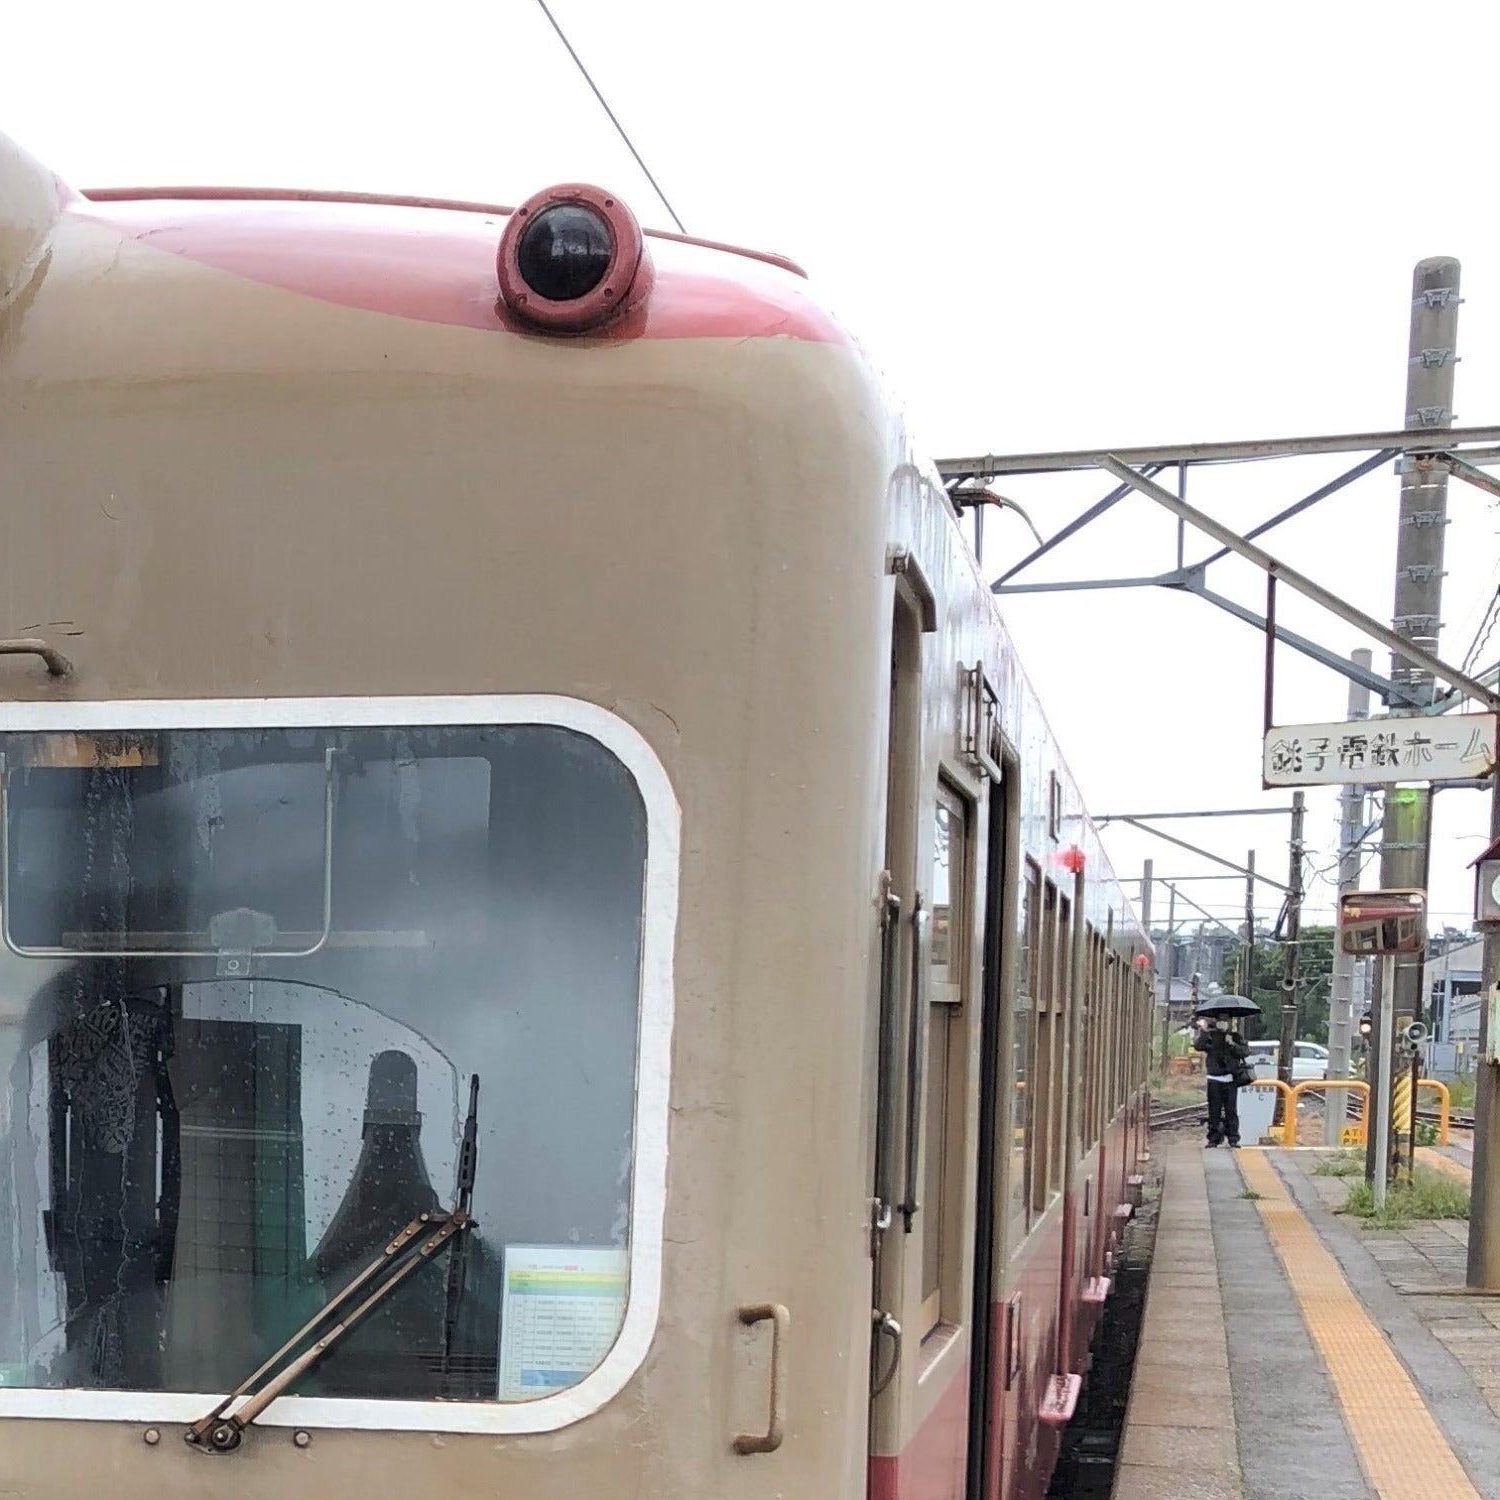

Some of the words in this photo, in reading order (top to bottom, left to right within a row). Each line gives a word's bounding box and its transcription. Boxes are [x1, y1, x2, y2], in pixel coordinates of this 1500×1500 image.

[1270, 727, 1497, 773] 銚子電鉄ホーム
